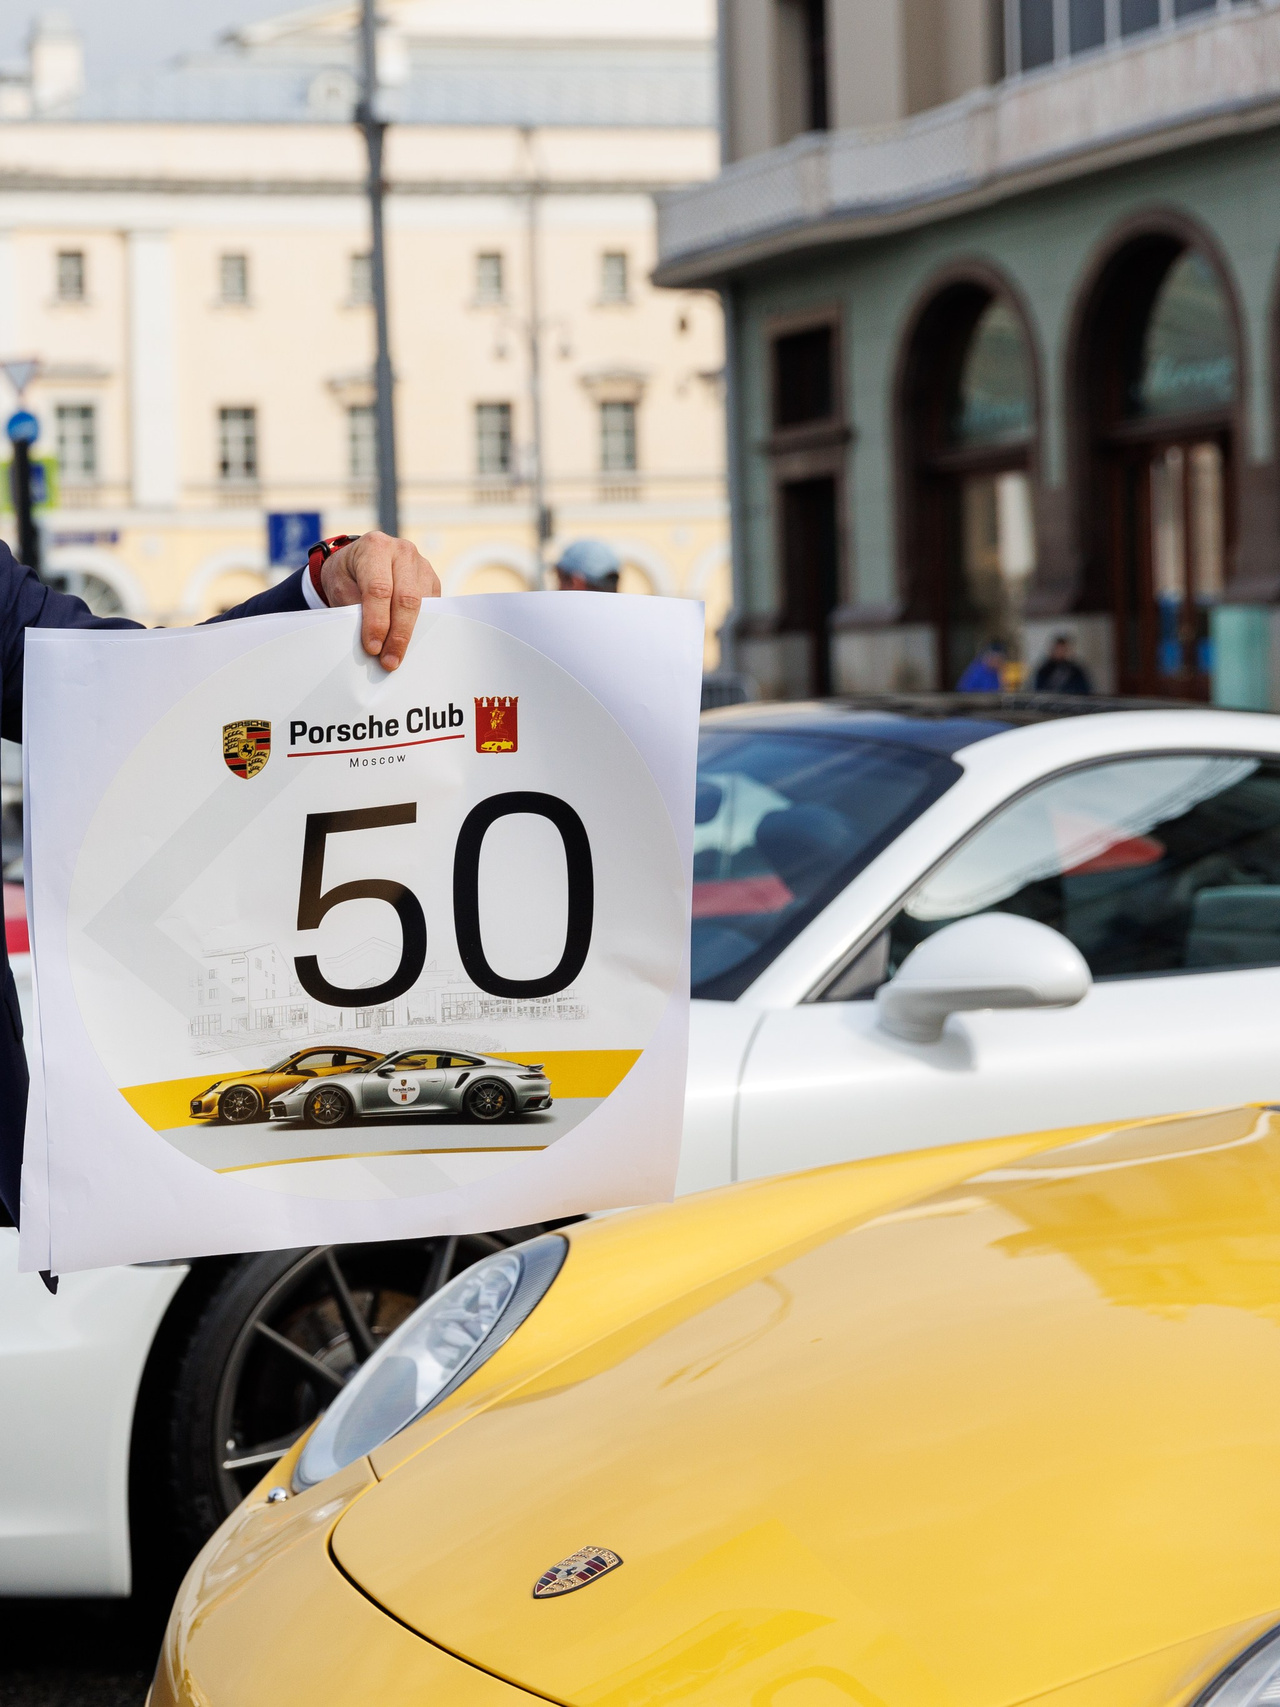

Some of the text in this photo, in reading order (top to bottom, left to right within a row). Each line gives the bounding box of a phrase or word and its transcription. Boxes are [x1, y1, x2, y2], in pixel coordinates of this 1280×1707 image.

[223, 720, 270, 732] PORSCHE
[289, 702, 465, 746] Porsche Club
[349, 753, 407, 768] Moscow
[293, 790, 594, 1008] 50
